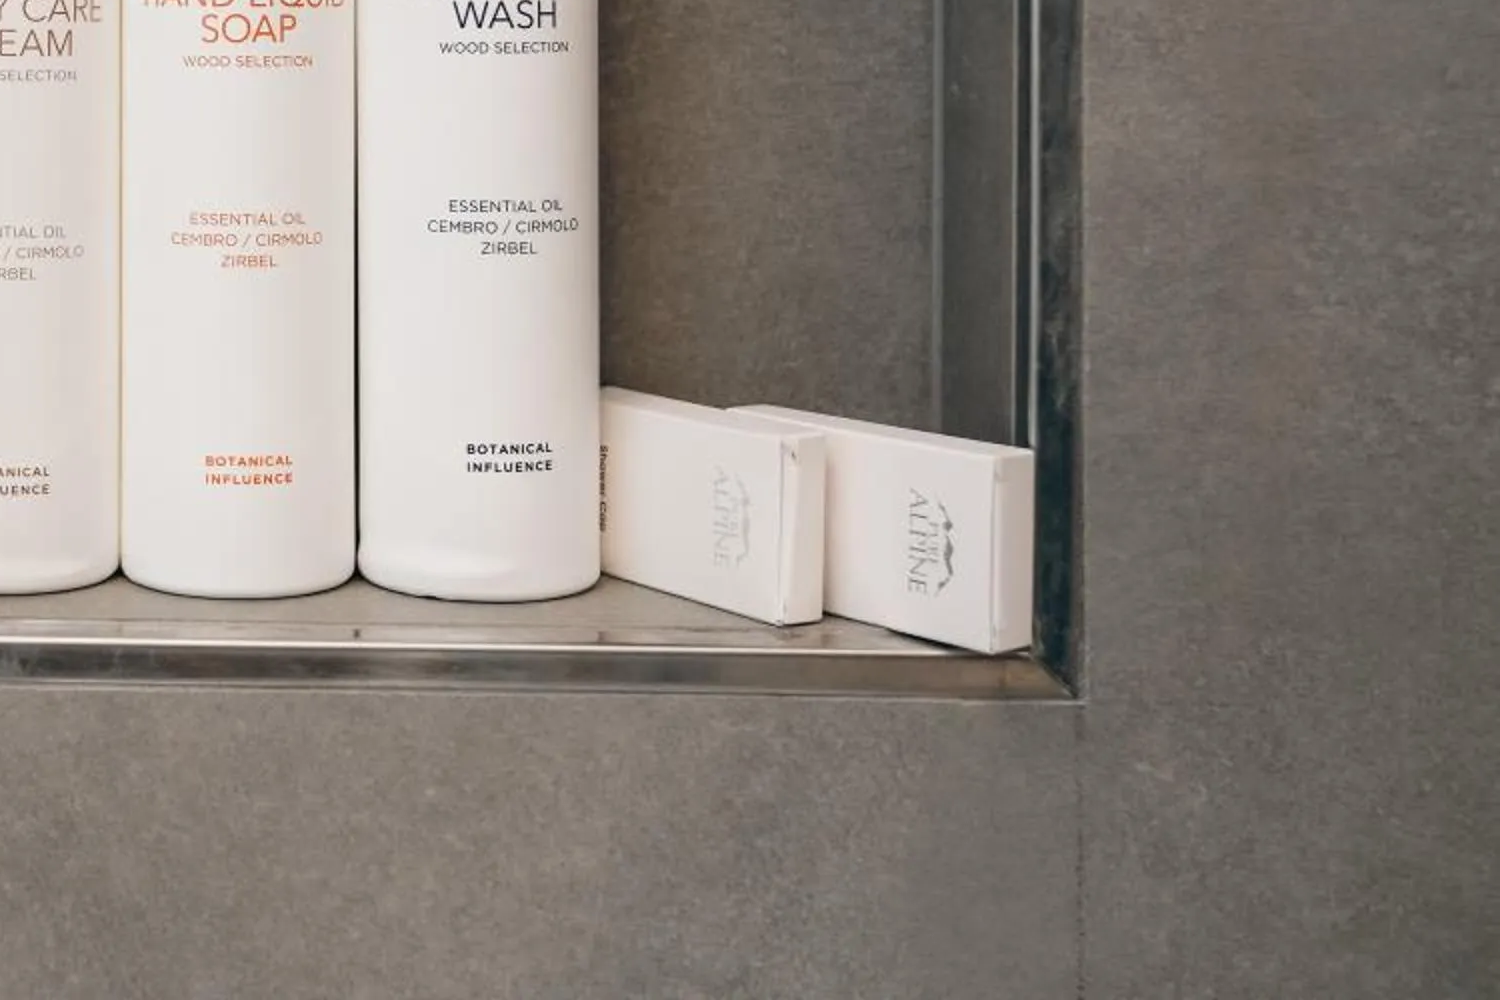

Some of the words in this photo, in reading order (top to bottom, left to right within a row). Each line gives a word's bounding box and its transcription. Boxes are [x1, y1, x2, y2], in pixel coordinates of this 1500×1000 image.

[452, 0, 557, 30] WASH
[201, 13, 297, 44] SOAP
[439, 41, 490, 55] WOOD
[493, 41, 569, 55] SELECTION
[182, 54, 232, 69] WOOD
[235, 54, 314, 69] SELECTION
[448, 199, 537, 213] ESSENTIAL
[541, 199, 563, 213] OIL
[189, 211, 278, 227] ESSENTIAL
[280, 212, 306, 226] OIL
[42, 224, 66, 239] OIL
[427, 219, 499, 235] CEMBRO
[501, 219, 512, 237] /
[515, 217, 579, 234] CIRMOLO
[170, 231, 238, 247] CEMBRO
[241, 233, 252, 249] /
[255, 231, 323, 247] CIRMOLO
[2, 246, 12, 262] /
[15, 244, 85, 260] CIRMOLO
[480, 241, 538, 256] ZIRBEL
[221, 253, 277, 269] ZIRBEL
[466, 442, 553, 455] BOTANICAL
[204, 455, 294, 468] BOTANICAL
[466, 459, 553, 473] INFLUENCE
[600, 444, 609, 496] Shower
[205, 472, 293, 486] INFLUENCE
[908, 487, 930, 595] ALPINE
